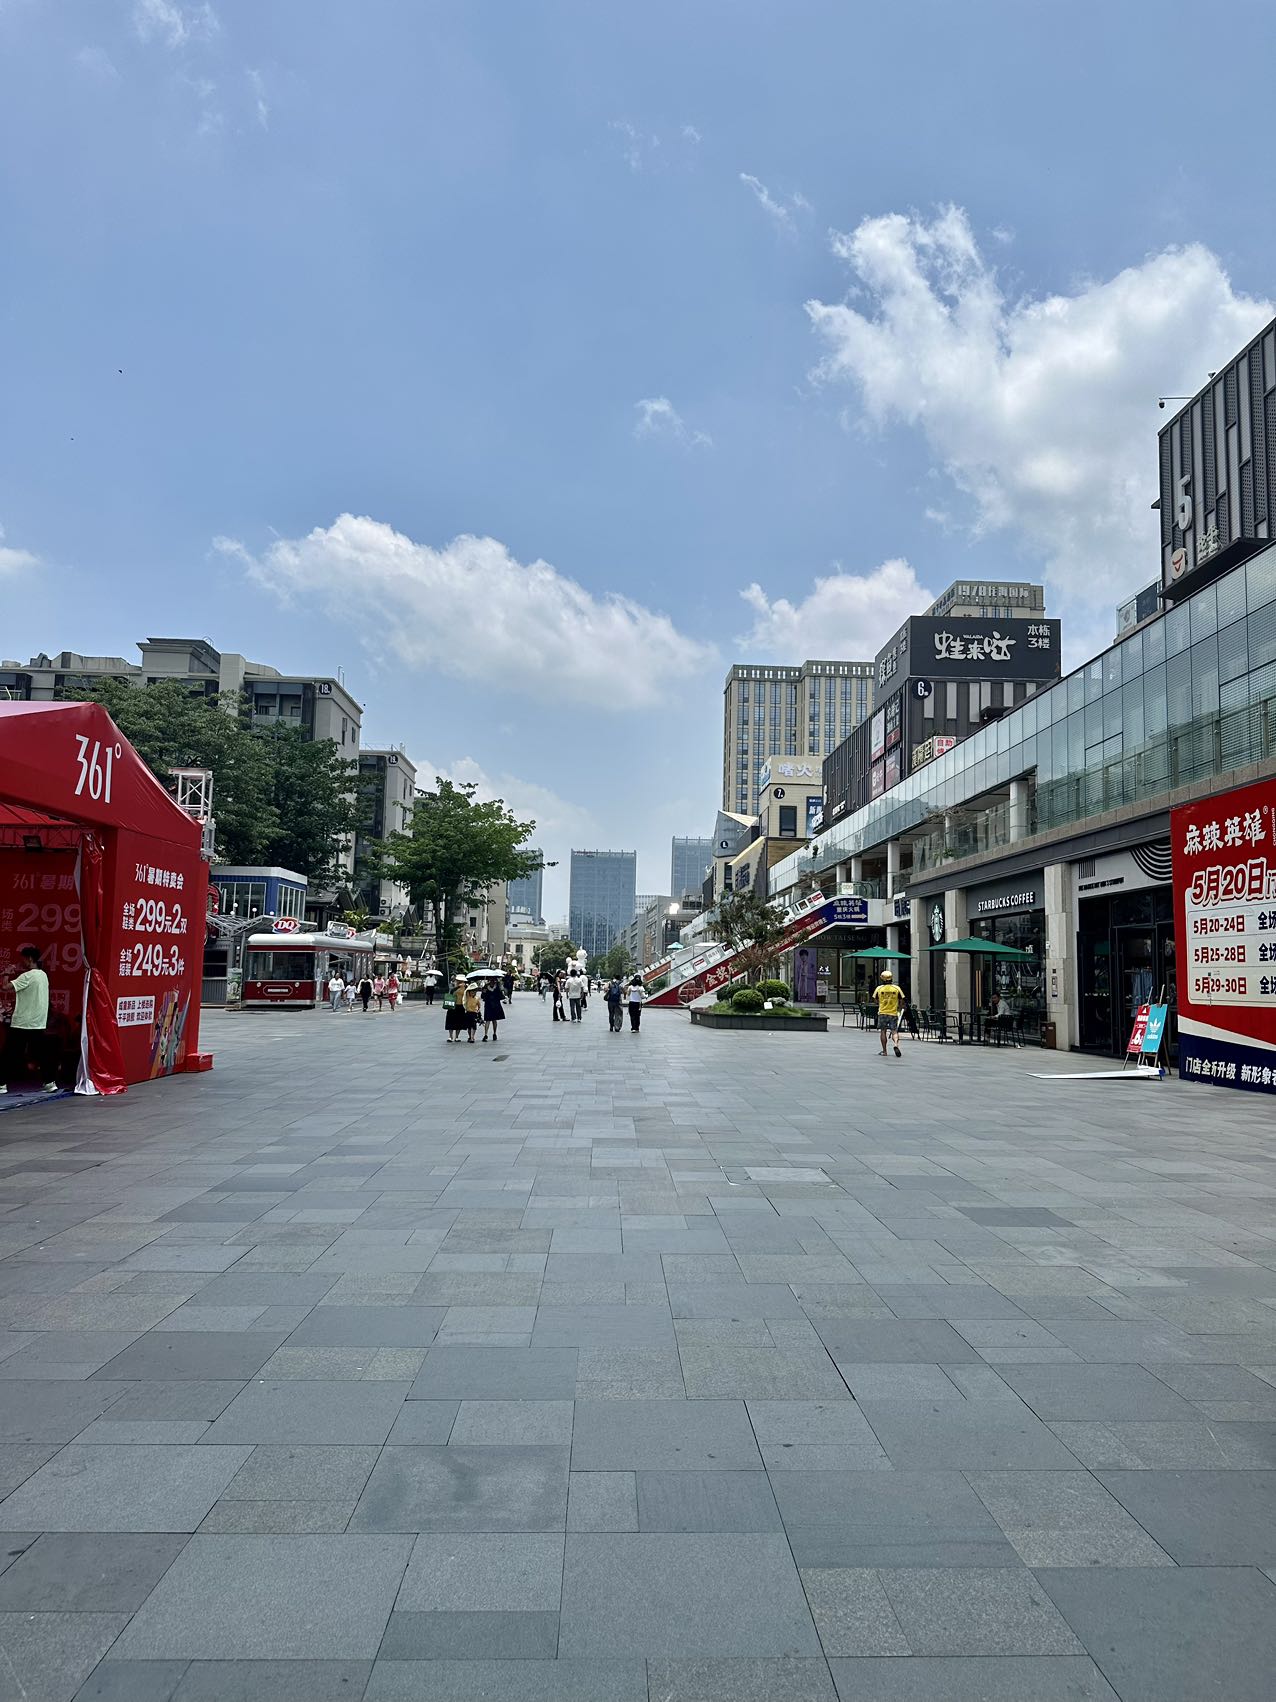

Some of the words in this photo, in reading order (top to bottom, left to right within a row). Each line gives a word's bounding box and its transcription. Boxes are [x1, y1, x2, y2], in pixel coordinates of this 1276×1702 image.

[1178, 475, 1192, 530] 5
[1027, 625, 1051, 636] 本栋
[934, 630, 1016, 661] 蛙来哒
[1027, 638, 1051, 649] 3楼
[1184, 808, 1267, 855] 麻辣英雄
[978, 896, 1010, 912] STARBUCKS
[1010, 891, 1034, 906] COFFEE
[277, 920, 294, 931] DQ
[1193, 914, 1245, 934] 5月20-24日
[1194, 945, 1246, 964] 5月25-28日
[1195, 977, 1247, 995] 5月29-30日
